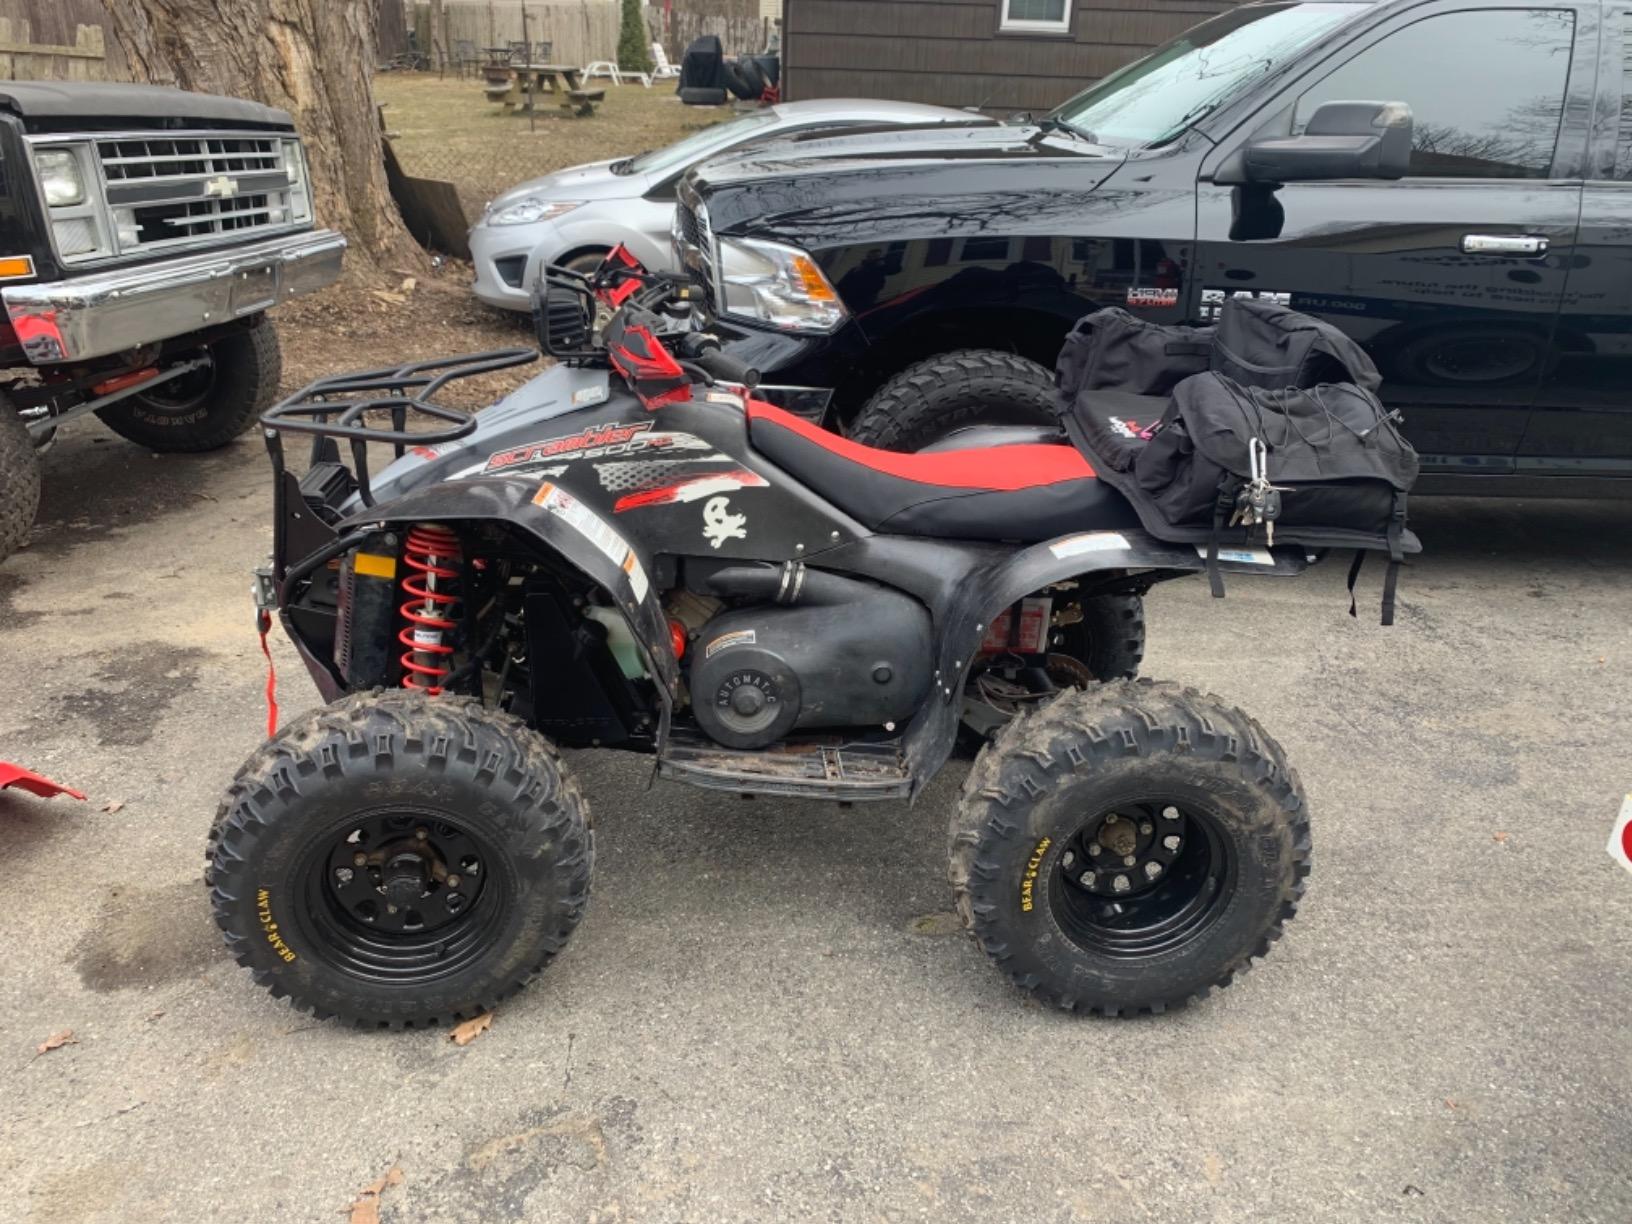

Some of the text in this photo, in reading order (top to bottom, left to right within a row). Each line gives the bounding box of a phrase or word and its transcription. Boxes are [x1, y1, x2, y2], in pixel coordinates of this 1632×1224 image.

[718, 674, 777, 706] AUTOMATIC
[1021, 836, 1051, 912] BEAR CLAW
[257, 889, 296, 962] BEAR CLAW
